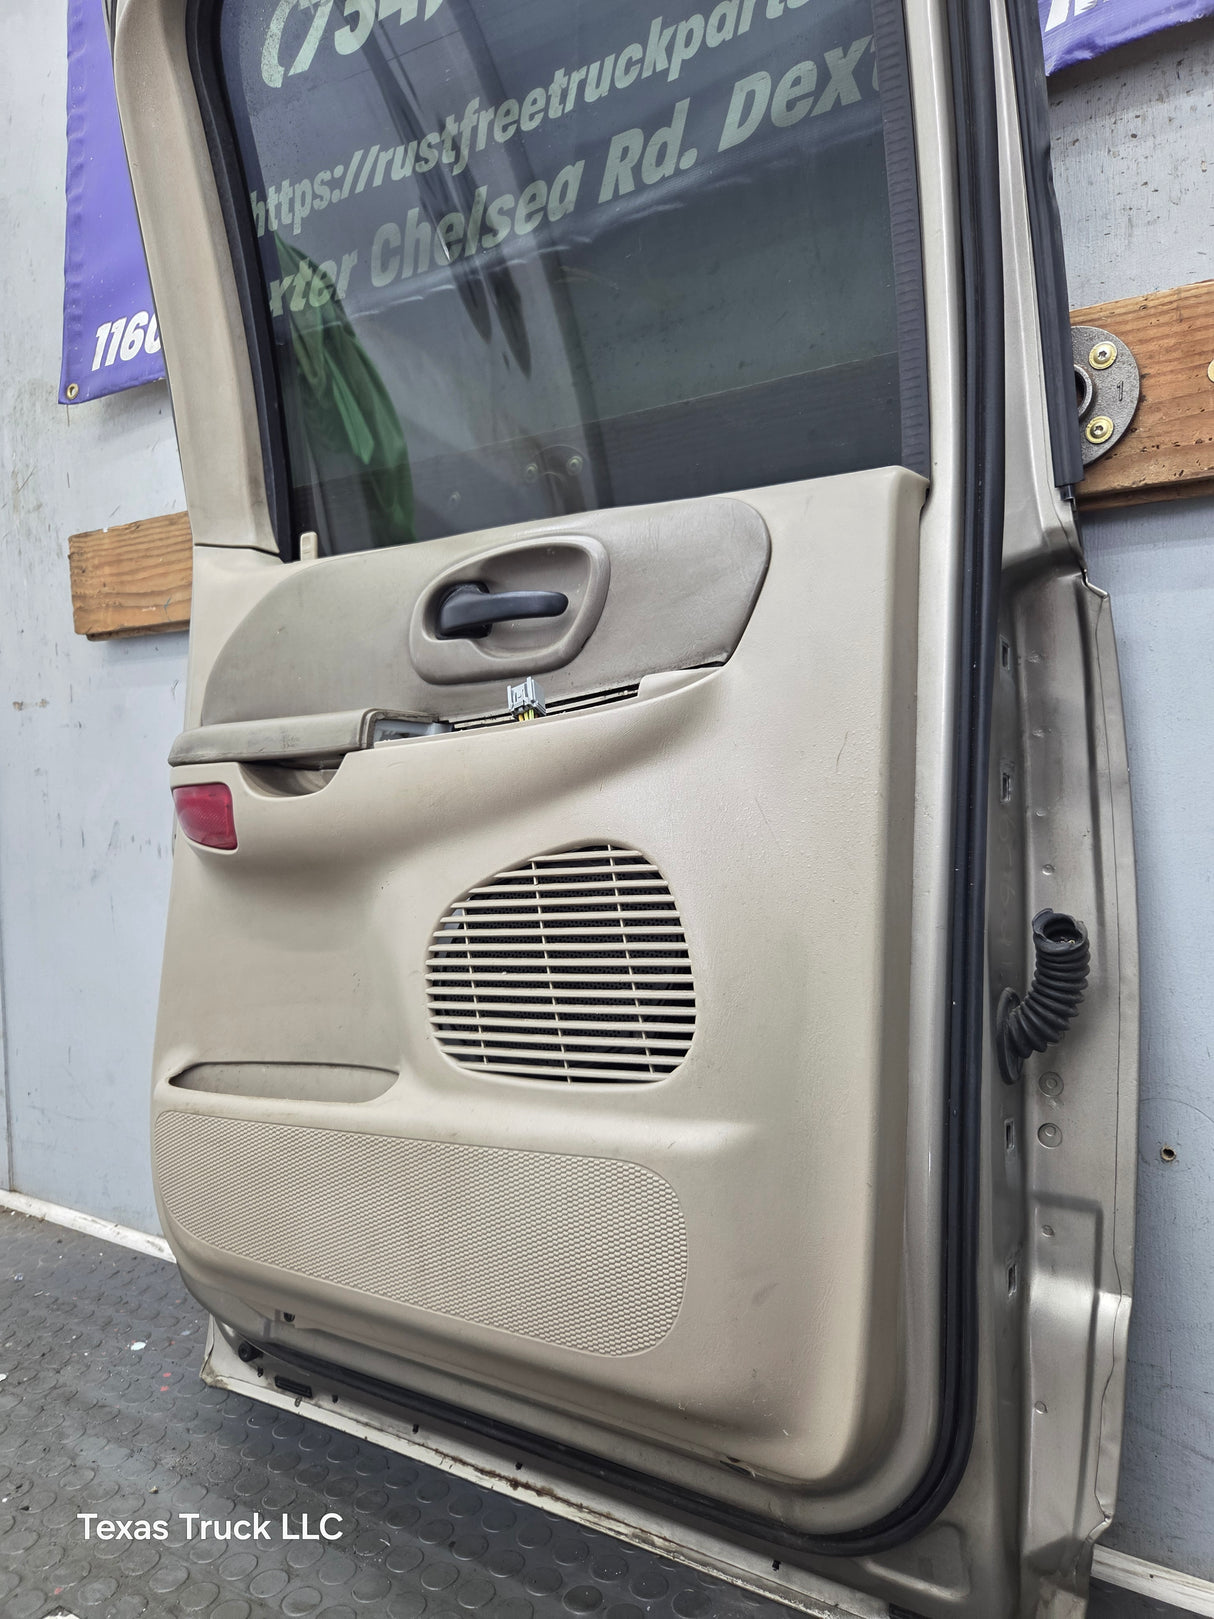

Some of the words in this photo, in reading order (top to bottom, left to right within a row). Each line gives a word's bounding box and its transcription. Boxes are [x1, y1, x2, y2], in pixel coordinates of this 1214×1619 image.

[370, 160, 585, 287] Chelsea
[598, 97, 698, 203] Rd.
[717, 34, 880, 152] Dex
